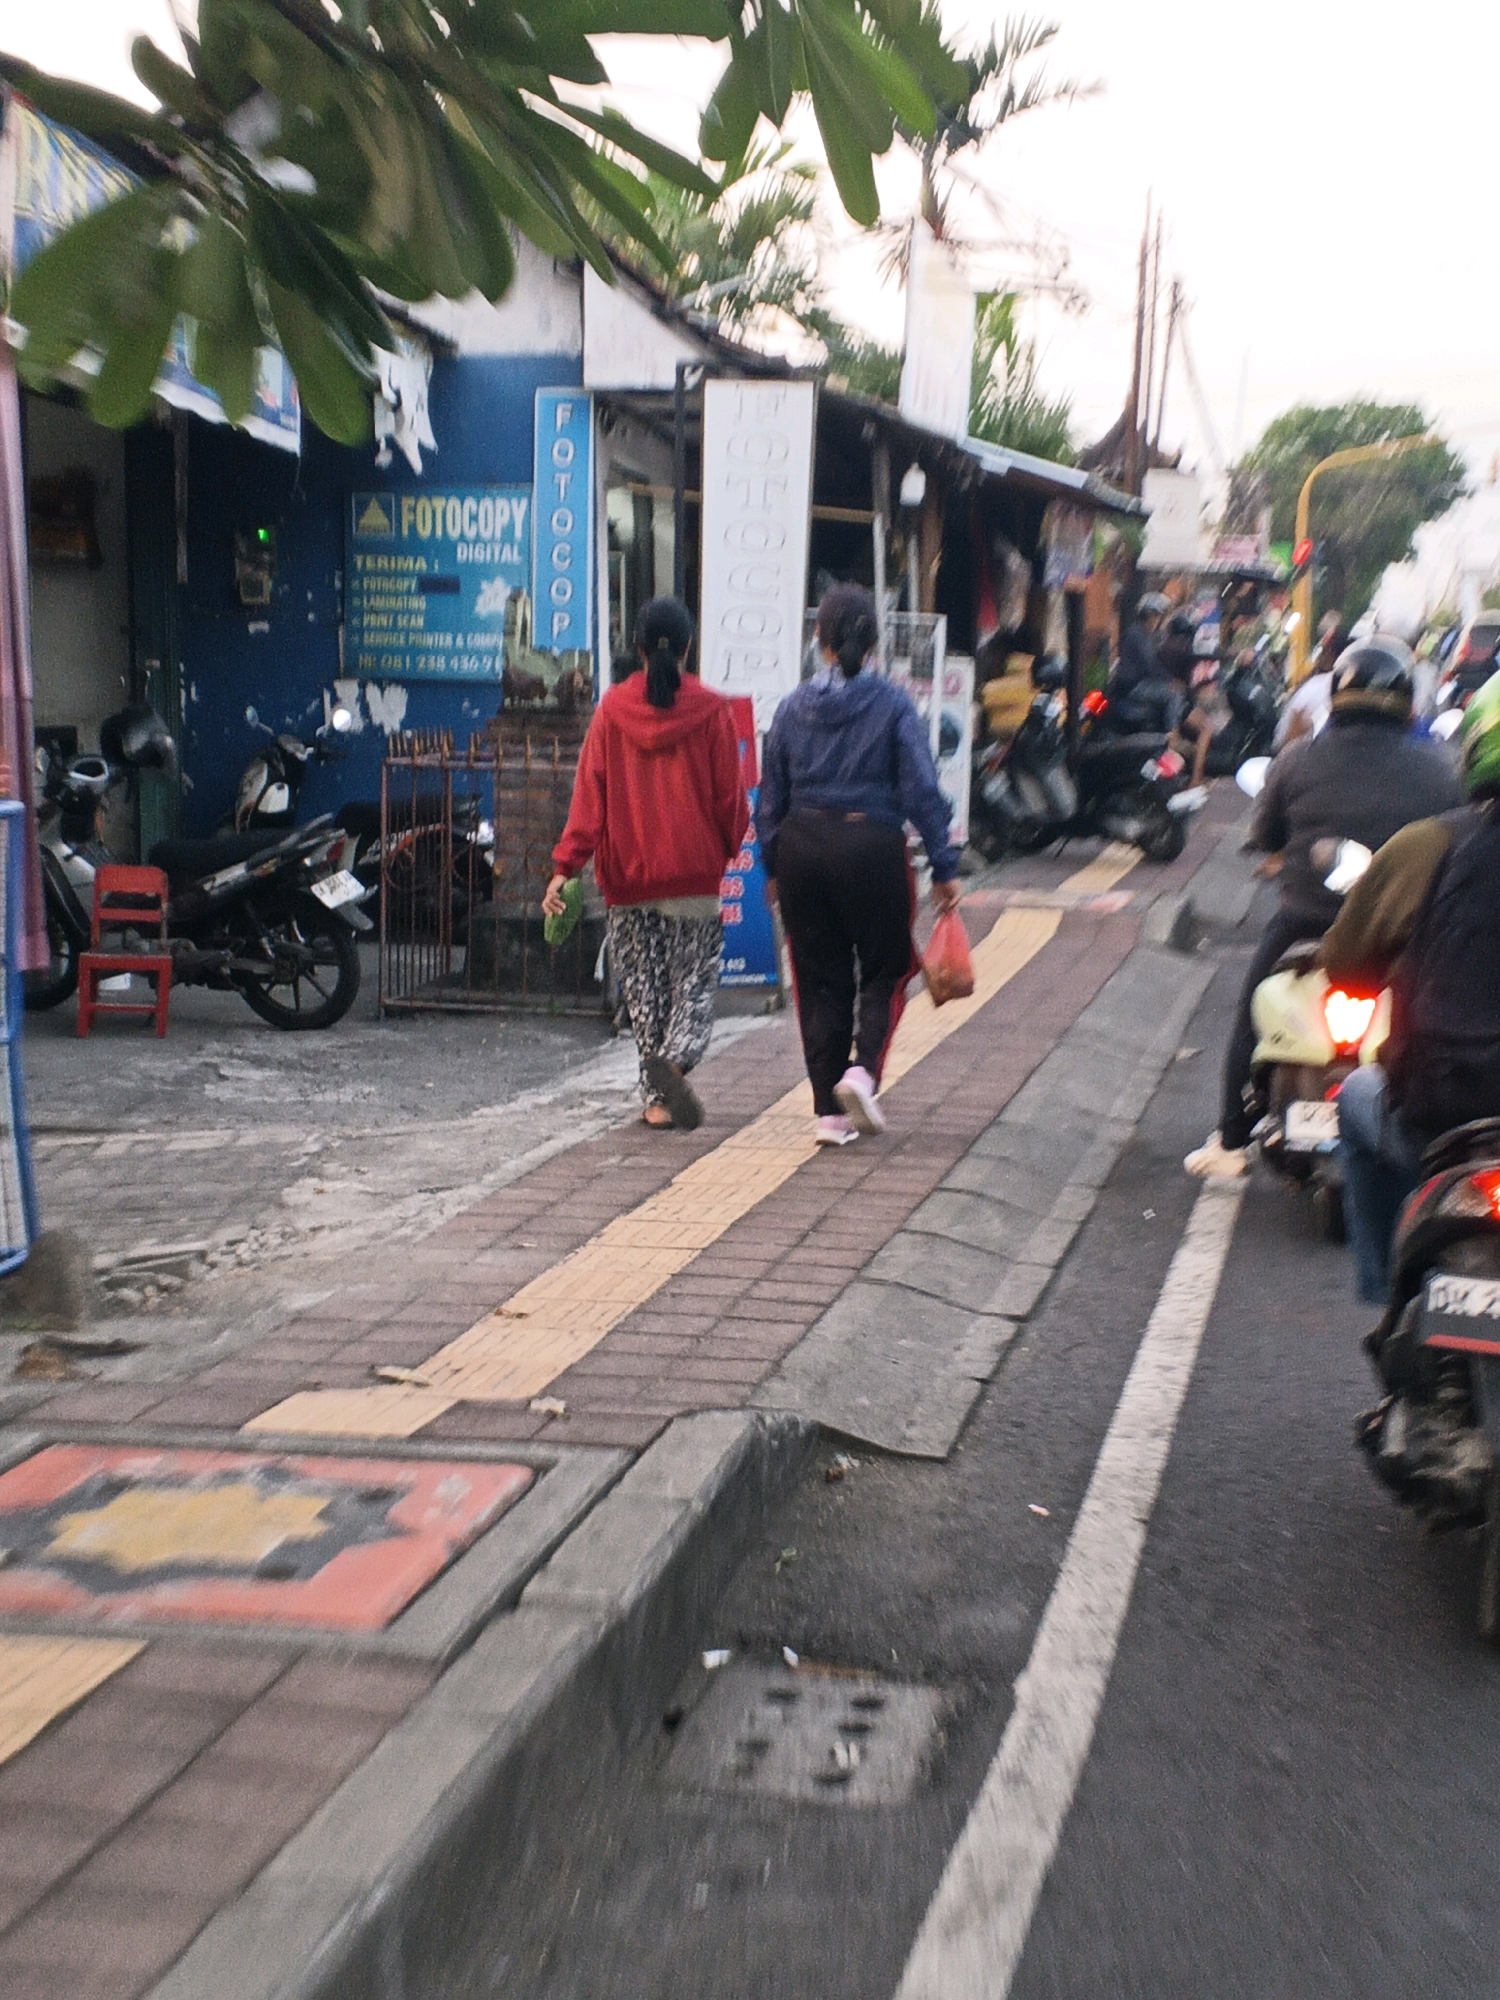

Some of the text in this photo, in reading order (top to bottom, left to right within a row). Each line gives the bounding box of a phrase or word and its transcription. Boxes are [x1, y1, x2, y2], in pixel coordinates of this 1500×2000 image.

[400, 495, 529, 541] FOTOCOPY
[456, 541, 522, 564] DIGITAL
[353, 554, 427, 572] TERIMA
[362, 576, 417, 593] FOTOCOPY
[362, 594, 426, 611] LAMINATING
